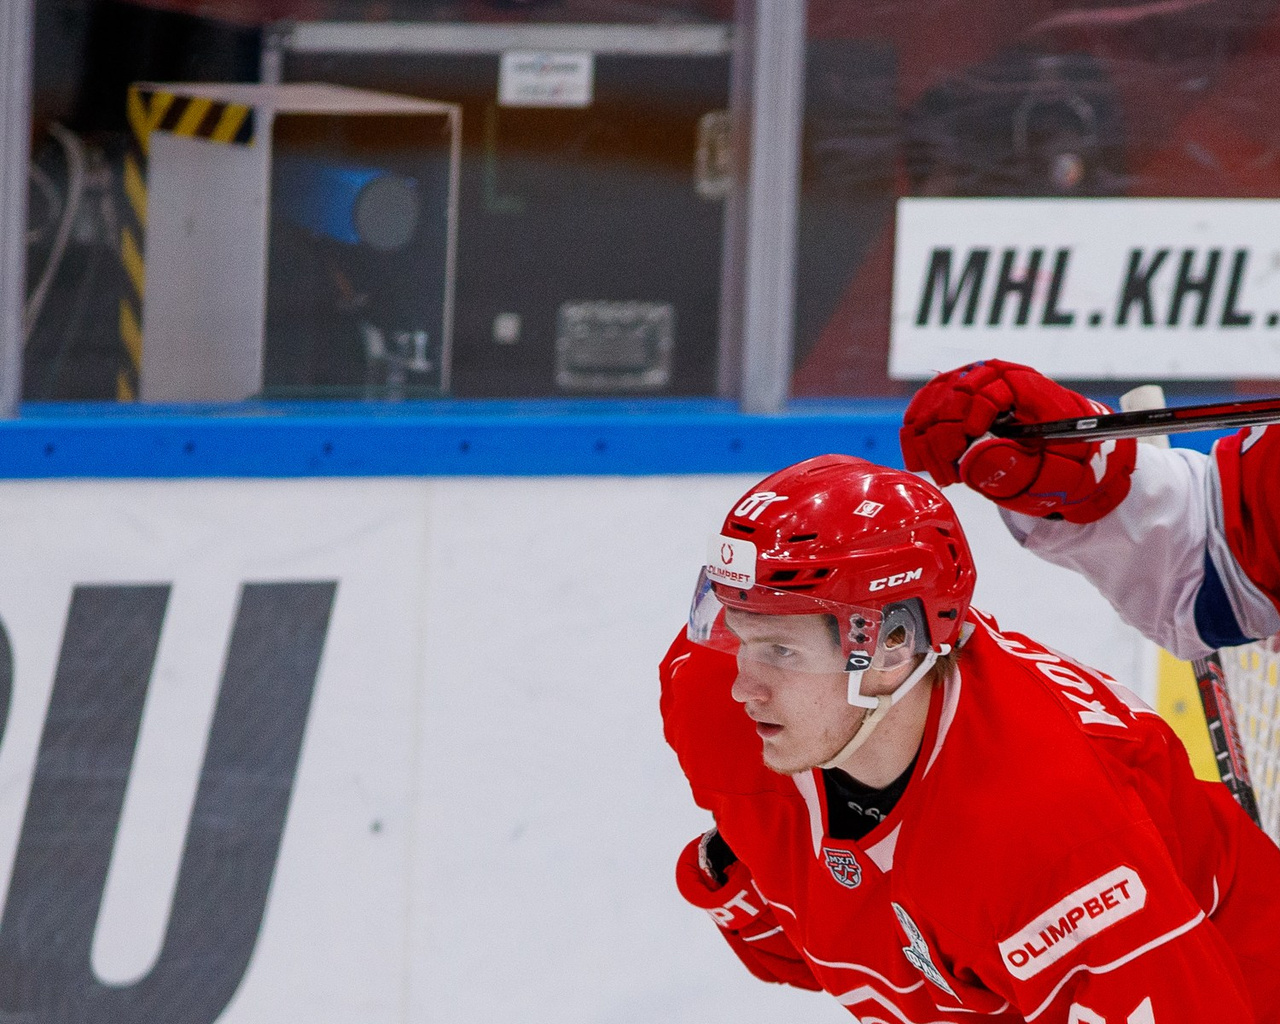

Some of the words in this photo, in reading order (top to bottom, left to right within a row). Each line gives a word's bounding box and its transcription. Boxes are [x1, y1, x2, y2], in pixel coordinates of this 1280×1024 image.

[734, 491, 790, 522] 81
[868, 567, 923, 592] CCM
[1006, 878, 1132, 969] OLIMPBET
